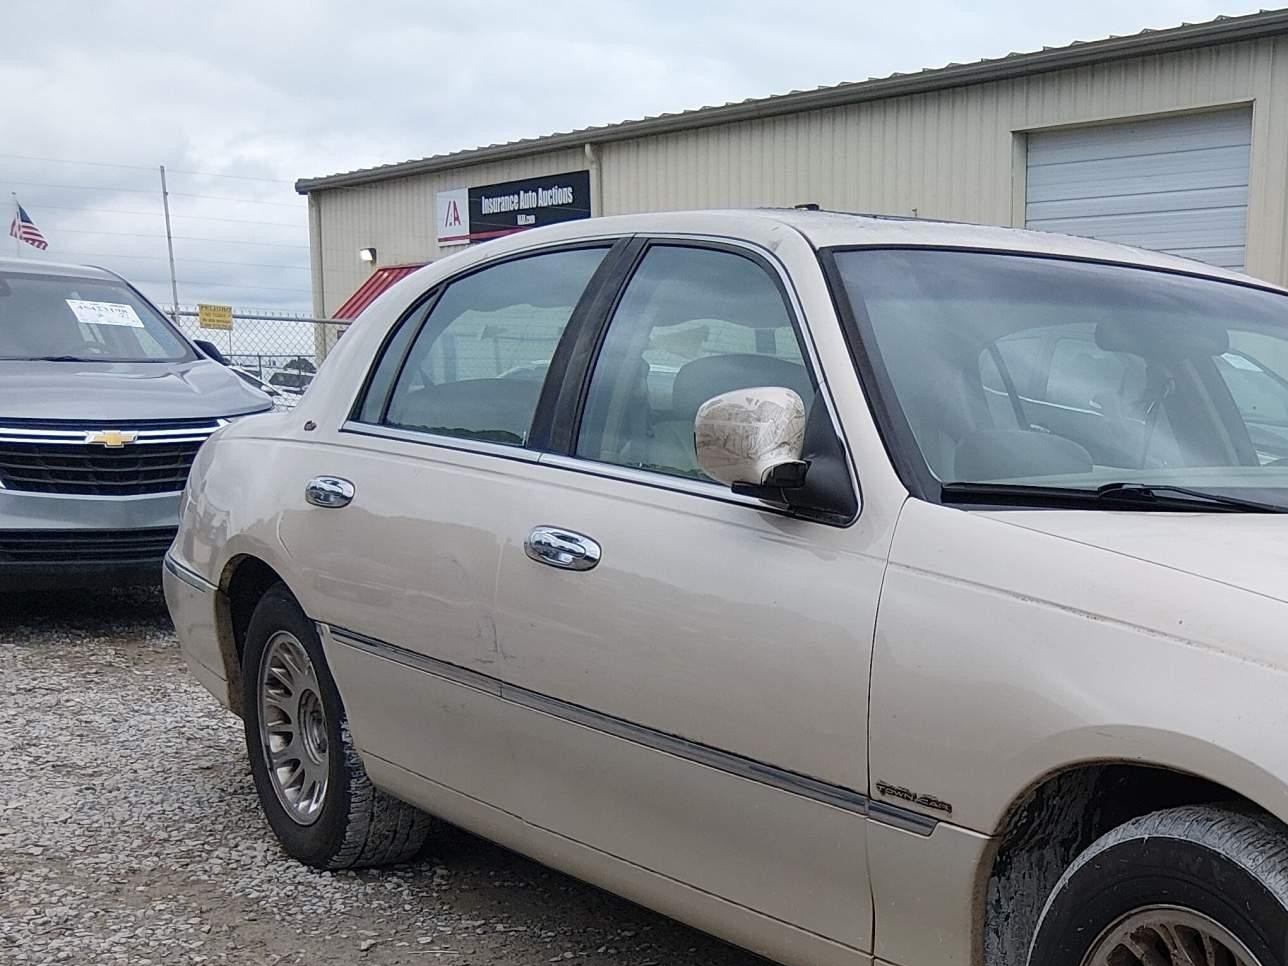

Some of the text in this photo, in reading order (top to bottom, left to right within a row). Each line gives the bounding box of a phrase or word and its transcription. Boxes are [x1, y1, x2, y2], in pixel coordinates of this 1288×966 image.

[481, 184, 574, 215] Insurance Auto Auctions
